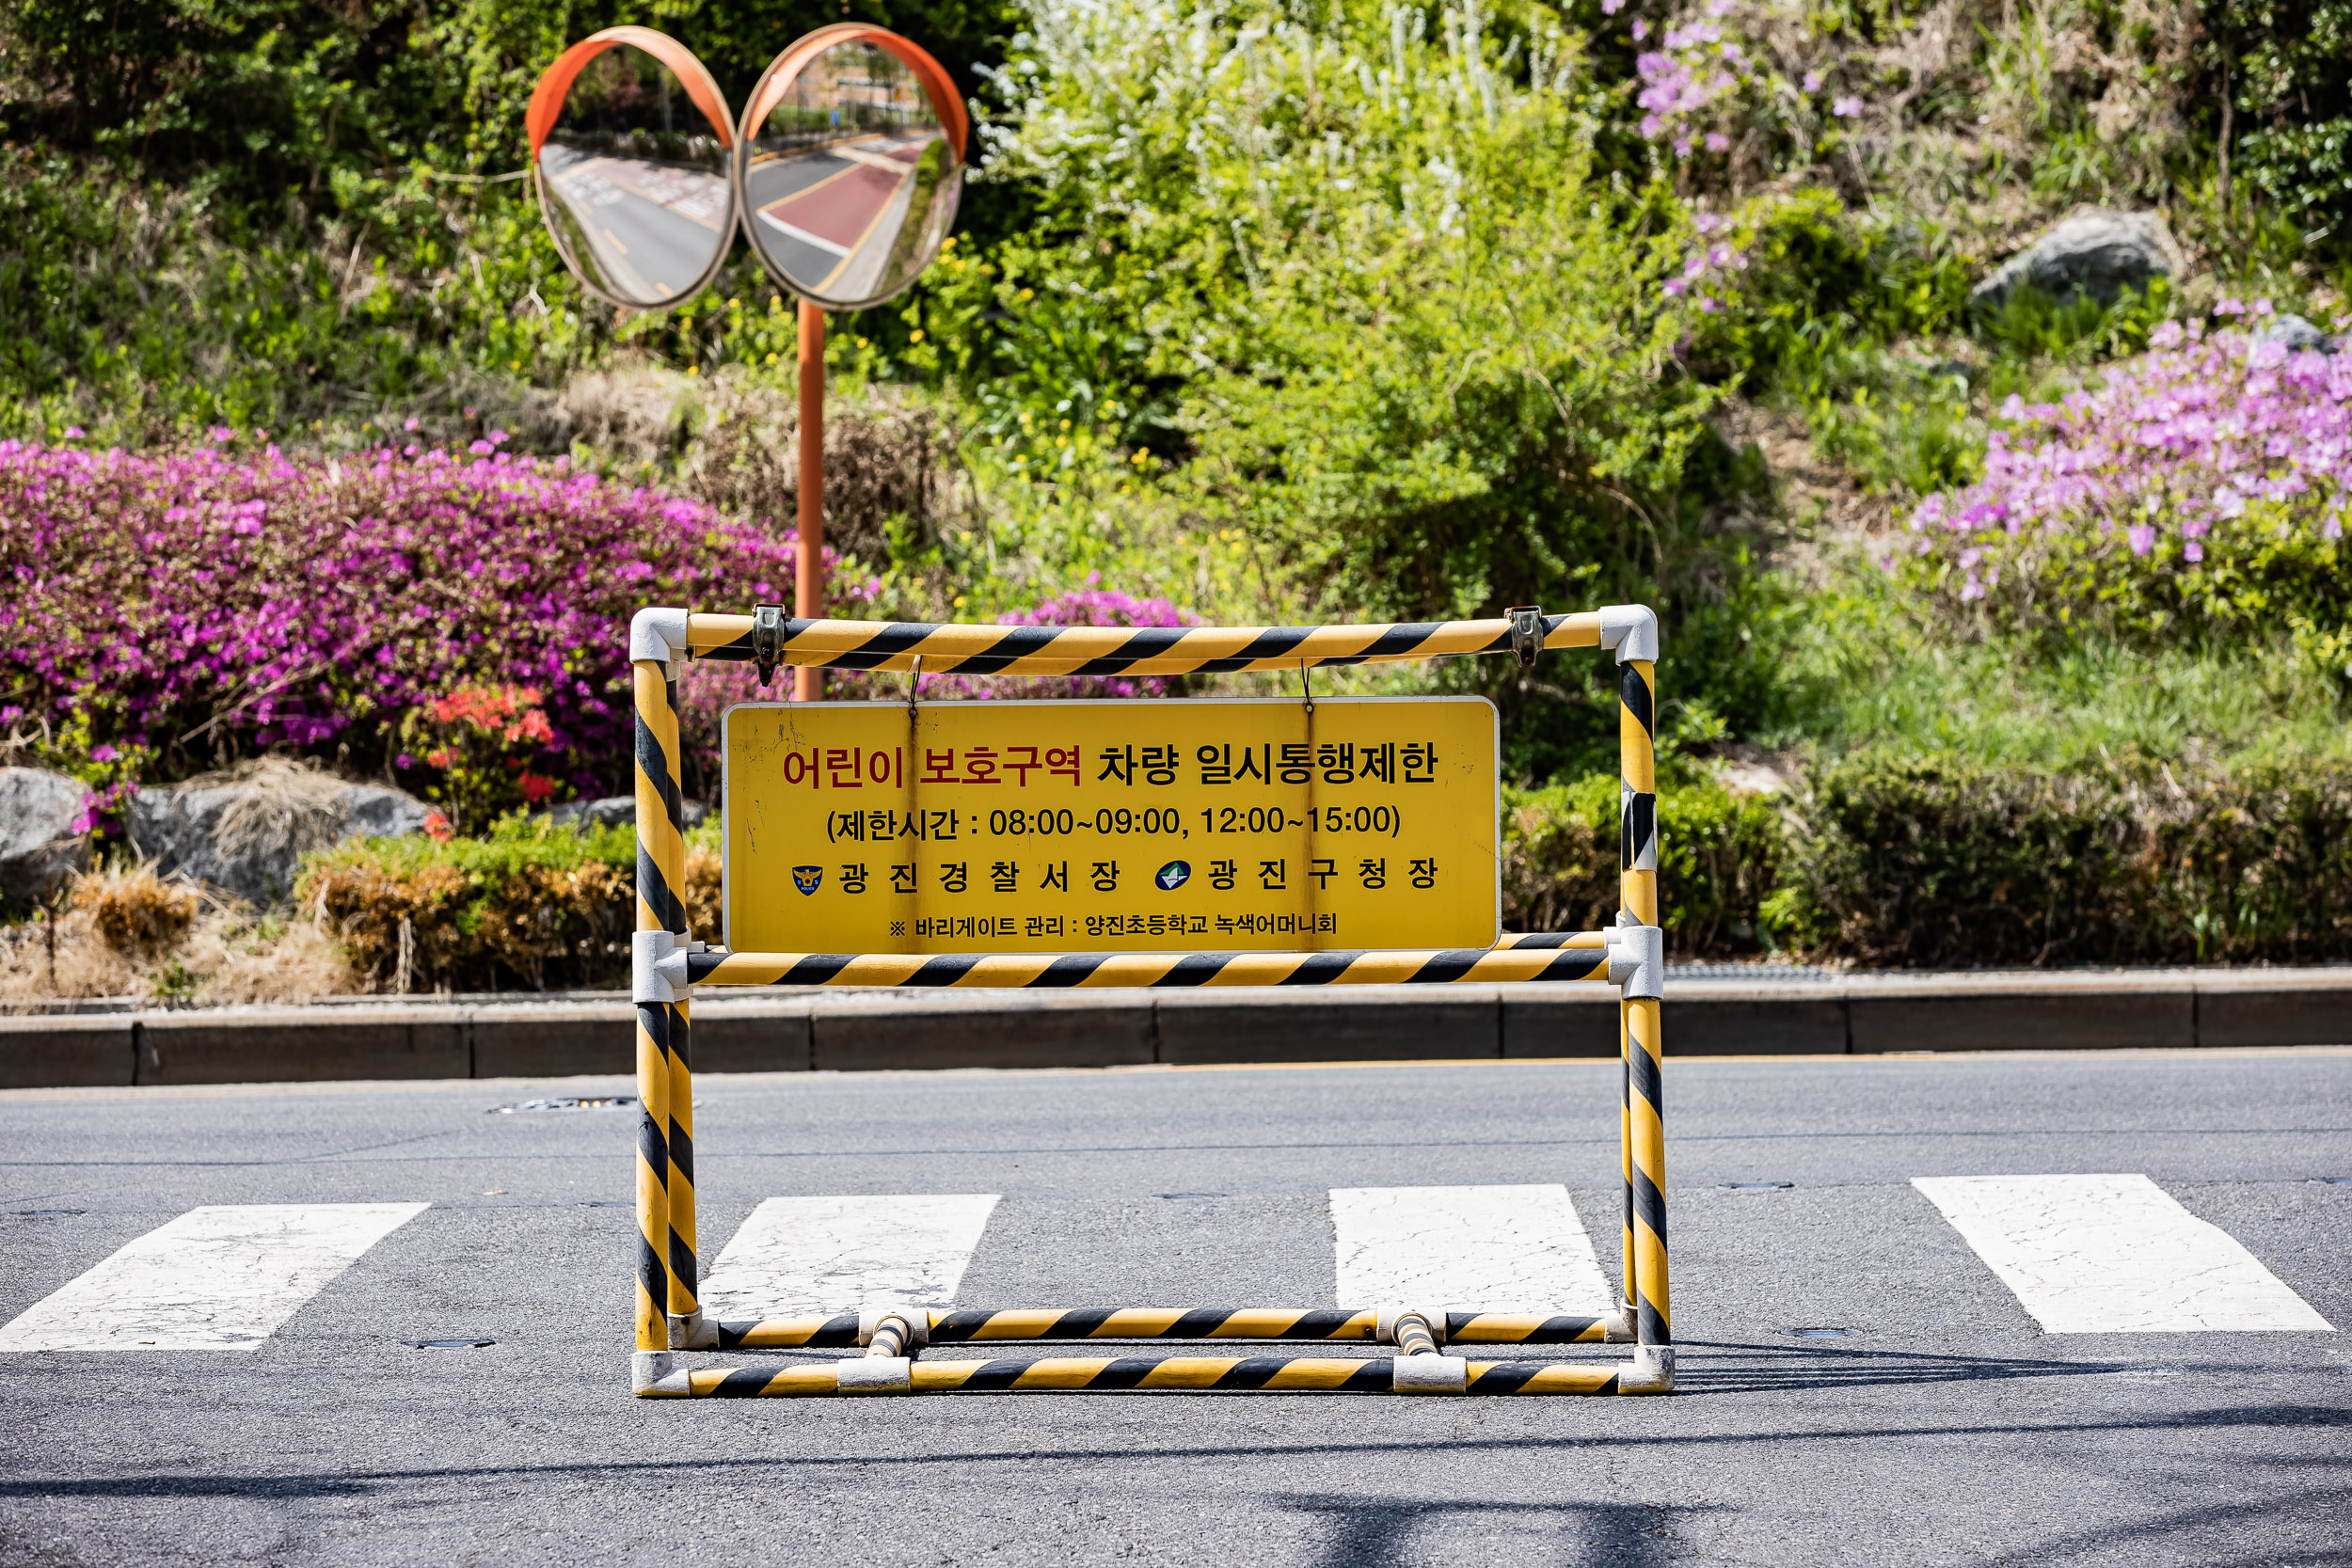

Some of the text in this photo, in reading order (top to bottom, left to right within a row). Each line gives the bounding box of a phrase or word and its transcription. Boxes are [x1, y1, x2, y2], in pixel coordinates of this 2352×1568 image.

[783, 740, 1438, 789] 어린이 보호구역 차량 일시통행제한
[826, 809, 960, 844] (제한시간
[989, 807, 1190, 841] 08:00~09:00,
[1200, 805, 1401, 839] 12:00~15:00)
[914, 916, 1018, 939] 바리게이트
[1024, 915, 1065, 938] 관리
[1085, 914, 1209, 937] 양진초등학교
[1214, 912, 1338, 936] 녹색어머니회
